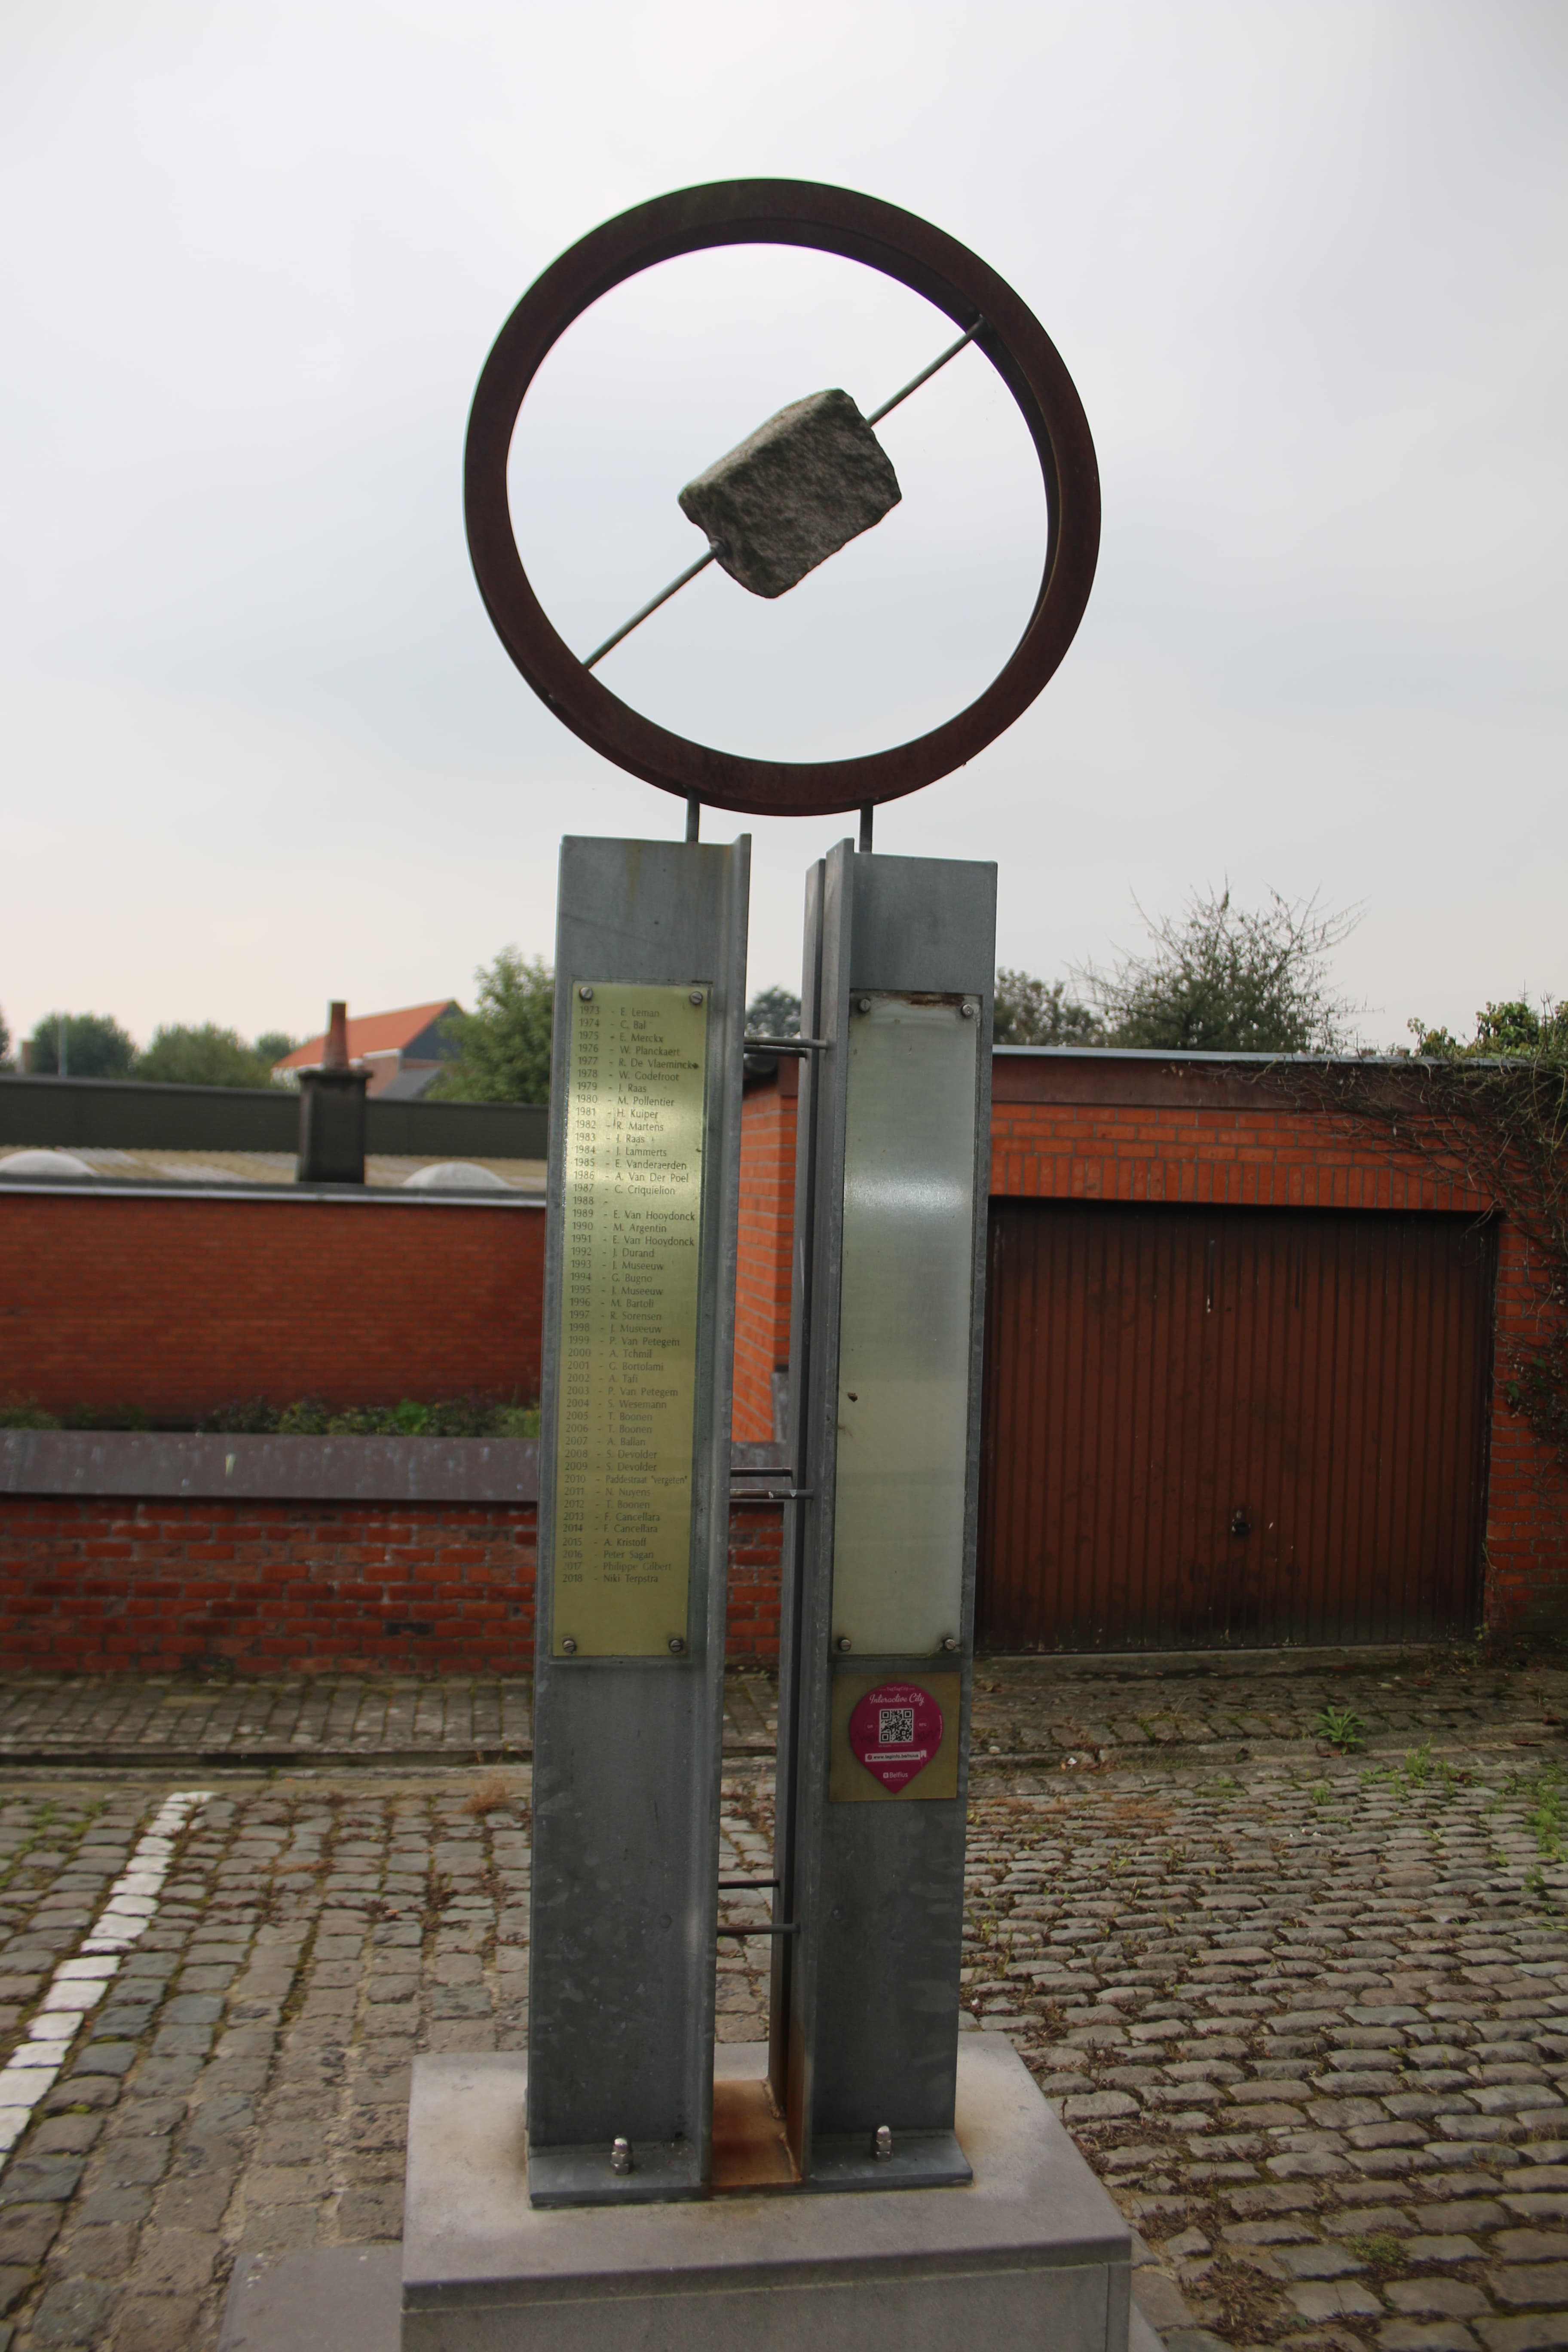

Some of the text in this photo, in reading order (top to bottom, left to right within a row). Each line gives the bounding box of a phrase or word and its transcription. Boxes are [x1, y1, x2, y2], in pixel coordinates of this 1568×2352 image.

[580, 1006, 659, 1017] 1973 E. Leman
[579, 1018, 646, 1029] 1974 C. Bal
[579, 1031, 663, 1043] 1975 E. Merckx
[579, 1044, 680, 1056] 1976 W. Planckaert
[578, 1057, 692, 1069] 1977 R. De Vlaeminck
[578, 1069, 679, 1081] 1978 W. Godefroot
[577, 1082, 646, 1093] 1979 J. Raas
[577, 1095, 674, 1106] 1980 M. Pollentier
[576, 1107, 658, 1119] 1981 H. Kuiper
[576, 1120, 664, 1131] 1982 R. Martens
[575, 1133, 644, 1143] 1983 J. Raas
[575, 1145, 667, 1157] 1984 J. Lammerts
[574, 1158, 686, 1170] 1985 E. Vanderaerden
[574, 1171, 689, 1182] 1986 A. Van Der Poel
[573, 1184, 675, 1197] 1987 C. Criquielion
[573, 1196, 594, 1205] 1988
[573, 1209, 695, 1222] 1989 E. Van Hooydonck
[572, 1222, 666, 1234] 1990 M. Argentin
[572, 1234, 694, 1247] 1991 E. Van Hooydonck
[571, 1247, 654, 1258] 1992 J. Durand
[571, 1260, 664, 1270] 1993 J. Museeuw
[571, 1272, 652, 1284] 1994 G. Bugno
[571, 1285, 663, 1295] 1995 J. Museeuw
[570, 1298, 654, 1308] 1996 M. Bartoli
[569, 1311, 662, 1320] 1997 R. Sorensen
[569, 1323, 662, 1334] 1998 J. Museeuw
[568, 1335, 680, 1348] 1999 P. Van Petegem
[568, 1348, 652, 1358] 2000 A. Tchmil
[567, 1361, 664, 1371] 2001 G. Bortolami
[567, 1374, 638, 1383] 2002 A. Tafi
[608, 1387, 616, 1395] P.
[620, 1387, 636, 1395] Van
[641, 1387, 678, 1398] Petegem
[567, 1399, 666, 1409] 2004 S. Wesemann
[608, 1412, 615, 1421] T.
[620, 1412, 652, 1421] Boonen
[566, 1424, 652, 1434] 2006 T. Boonen
[566, 1437, 646, 1446] 2007 A. Ballan
[606, 1450, 613, 1458] S.
[618, 1450, 657, 1459] Devolder
[565, 1462, 657, 1471] 2009 S. Devolder
[565, 1475, 585, 1483] 2010
[606, 1475, 646, 1483] Paddestraat
[619, 1488, 650, 1498] Nuyens
[606, 1500, 612, 1508] T.
[618, 1500, 649, 1509] Boonen
[604, 1513, 612, 1521] F.
[616, 1512, 660, 1522] Cancellara
[563, 1524, 583, 1532] 2014
[614, 1524, 658, 1533] Cancellara
[563, 1537, 646, 1547] 2015 A. Kristoff
[604, 1550, 625, 1559] Peter
[629, 1550, 653, 1560] Sagan
[603, 1562, 637, 1572] Philippe
[643, 1562, 671, 1571] Gilbert
[563, 1574, 658, 1584] 2018 Niki Terpstra
[870, 1693, 925, 1706] Interactive City
